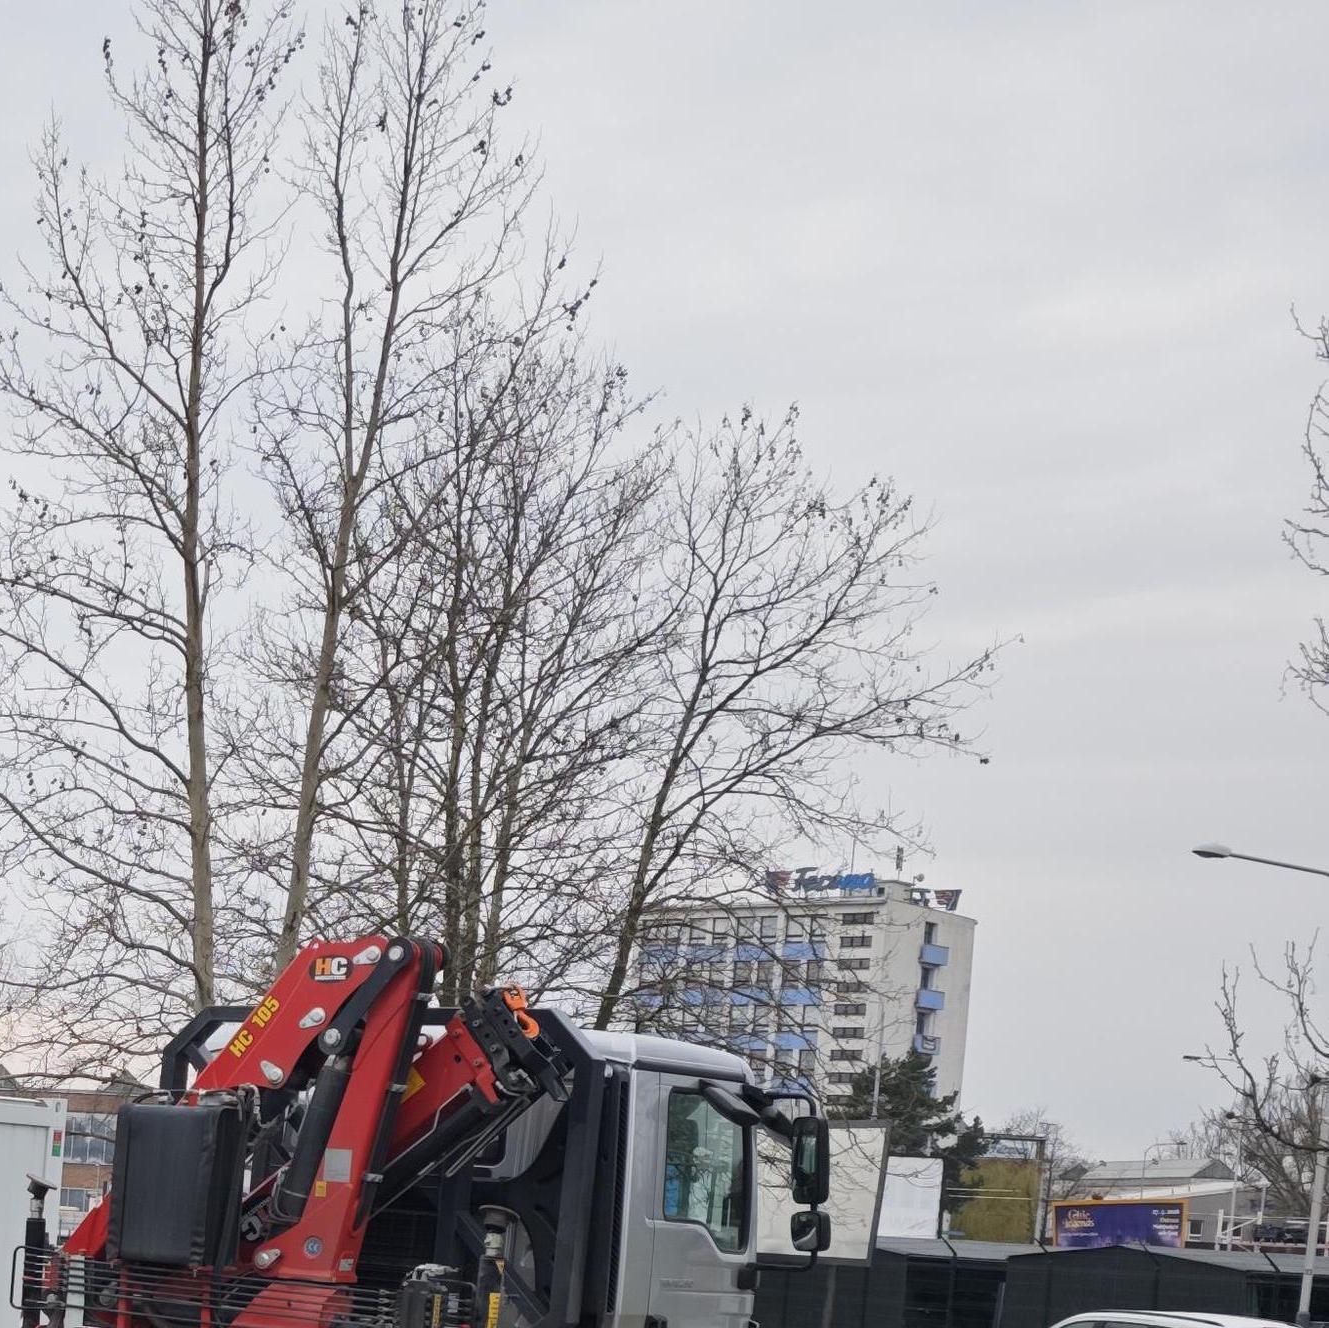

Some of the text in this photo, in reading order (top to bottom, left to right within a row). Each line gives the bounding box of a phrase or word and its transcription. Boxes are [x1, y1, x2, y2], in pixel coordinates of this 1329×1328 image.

[315, 956, 349, 976] HC
[229, 995, 280, 1058] HC 105
